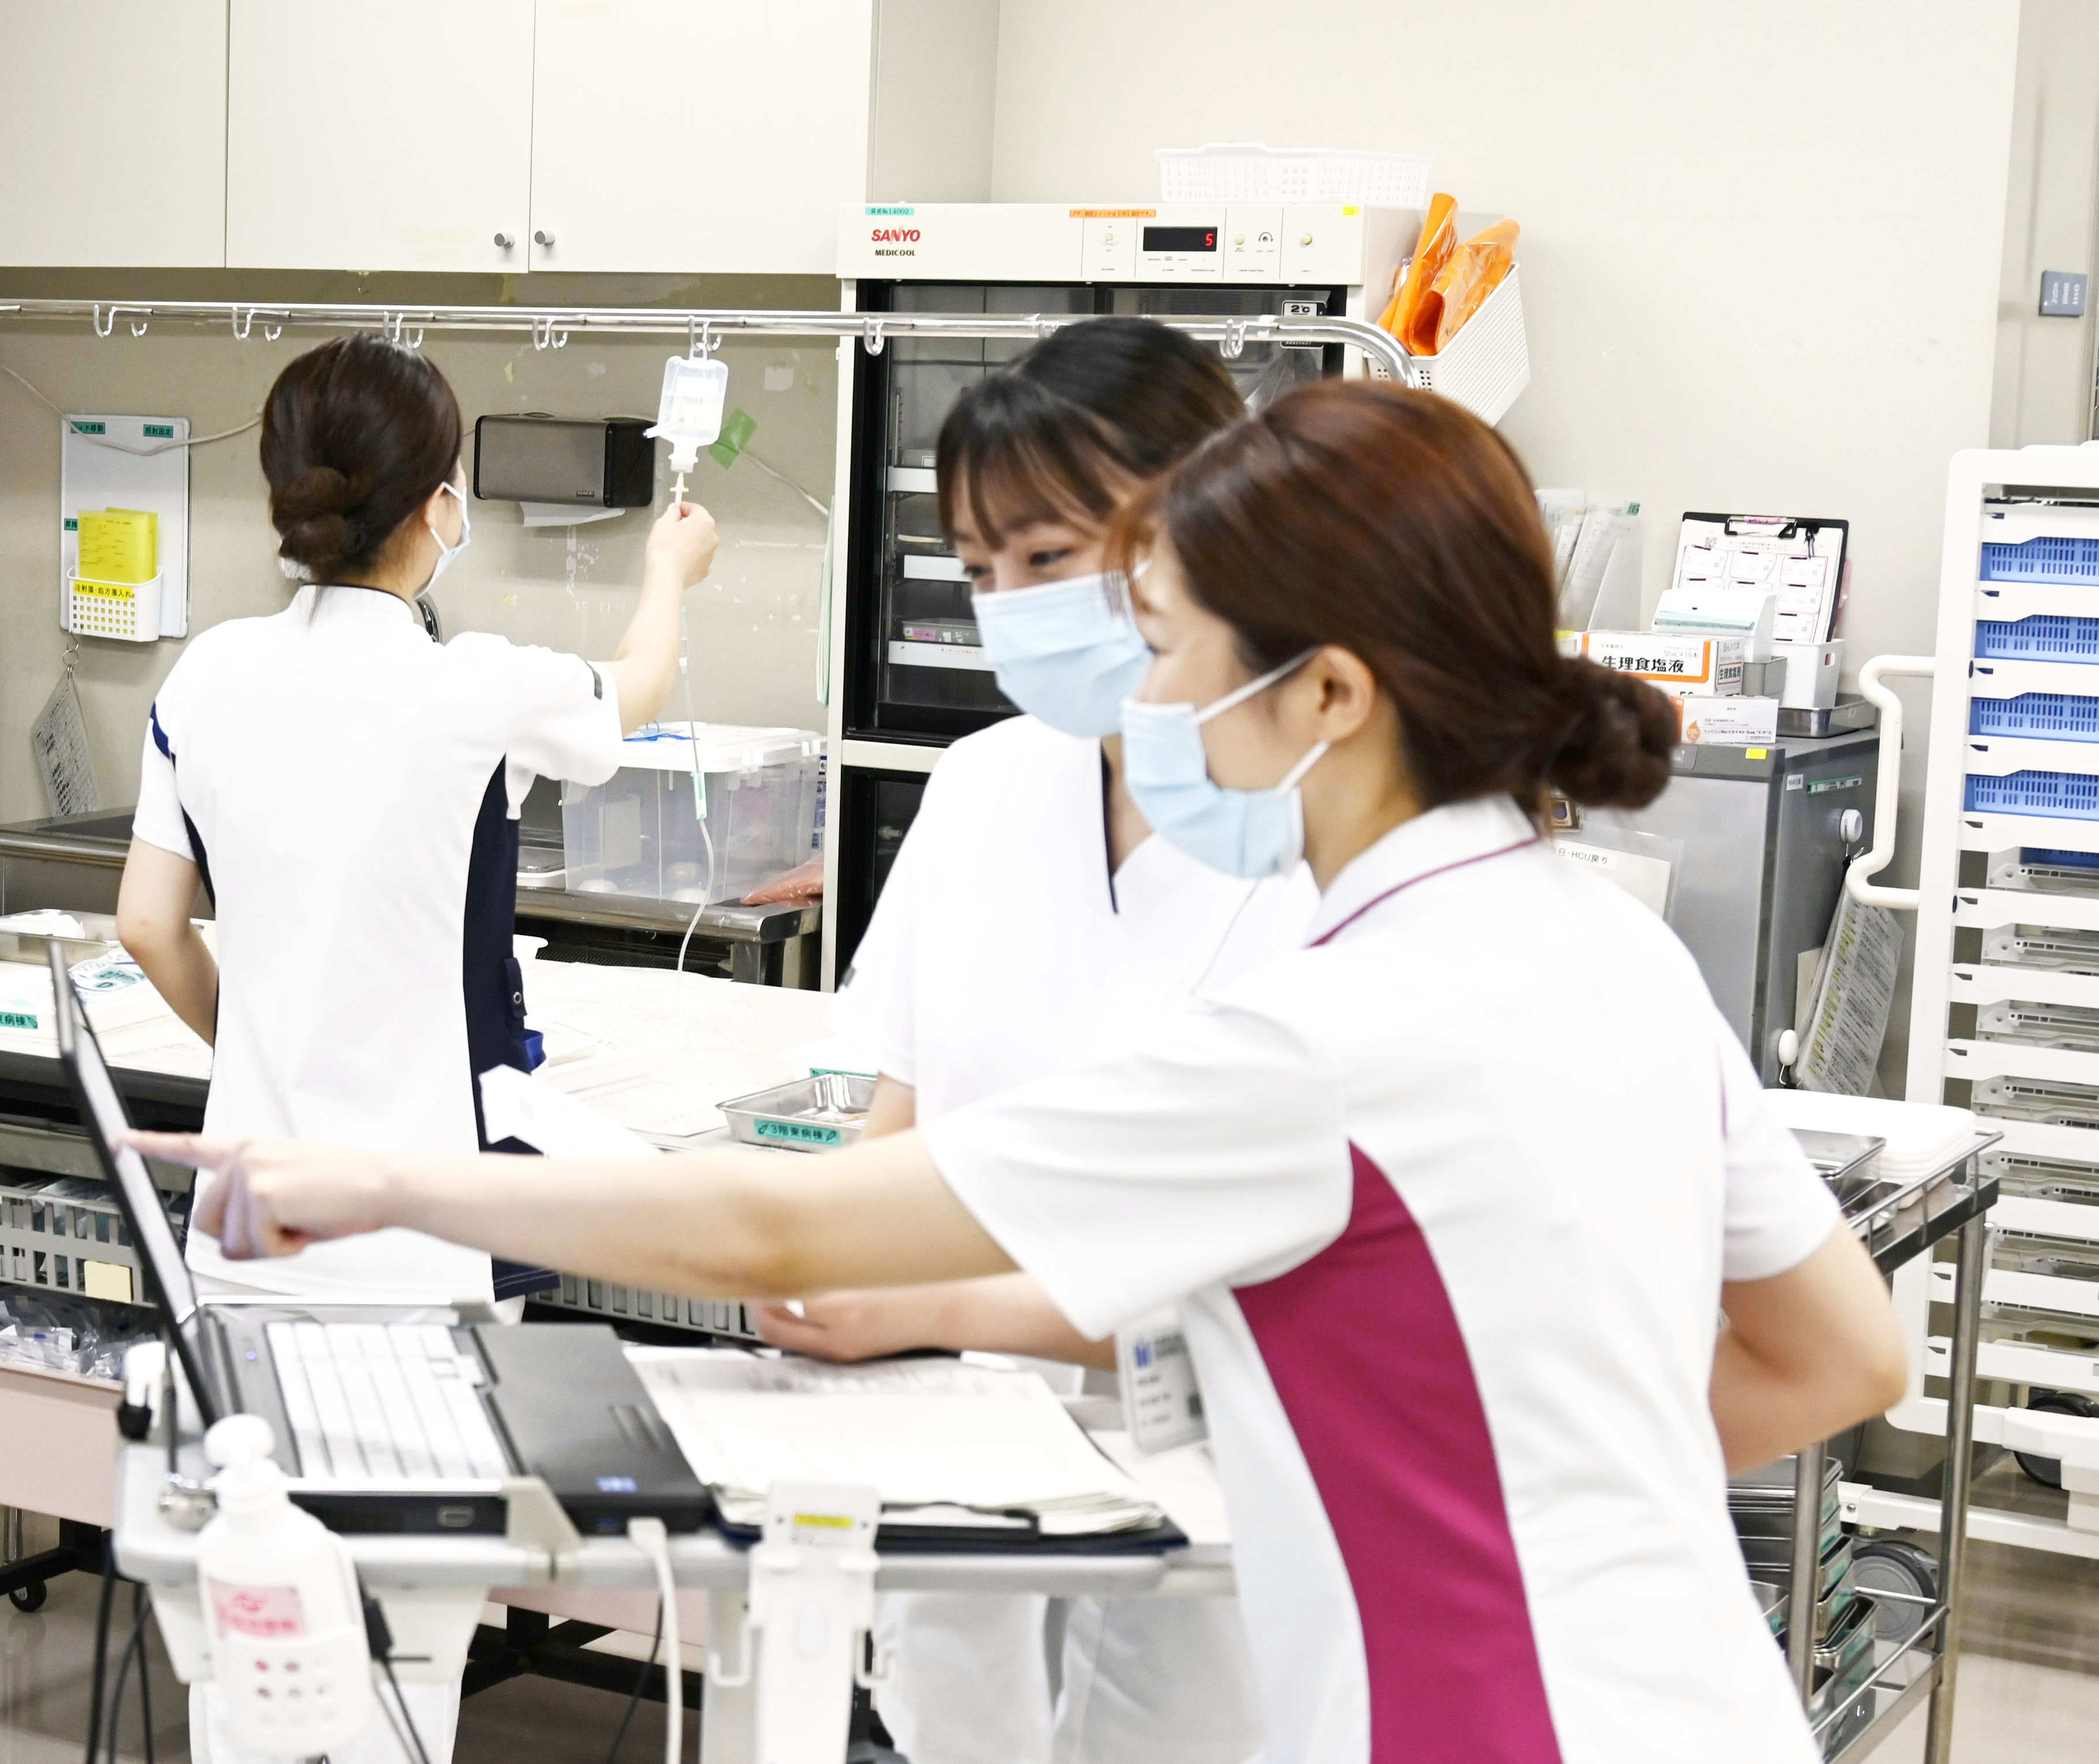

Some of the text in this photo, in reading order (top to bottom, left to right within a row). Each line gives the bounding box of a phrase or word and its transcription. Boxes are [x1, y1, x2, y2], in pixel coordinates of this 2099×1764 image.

[871, 227, 921, 243] SANYO
[1206, 233, 1214, 246] 5
[1602, 656, 1684, 673] 生理食塩液
[1554, 847, 1607, 865] 日・HCU戻り
